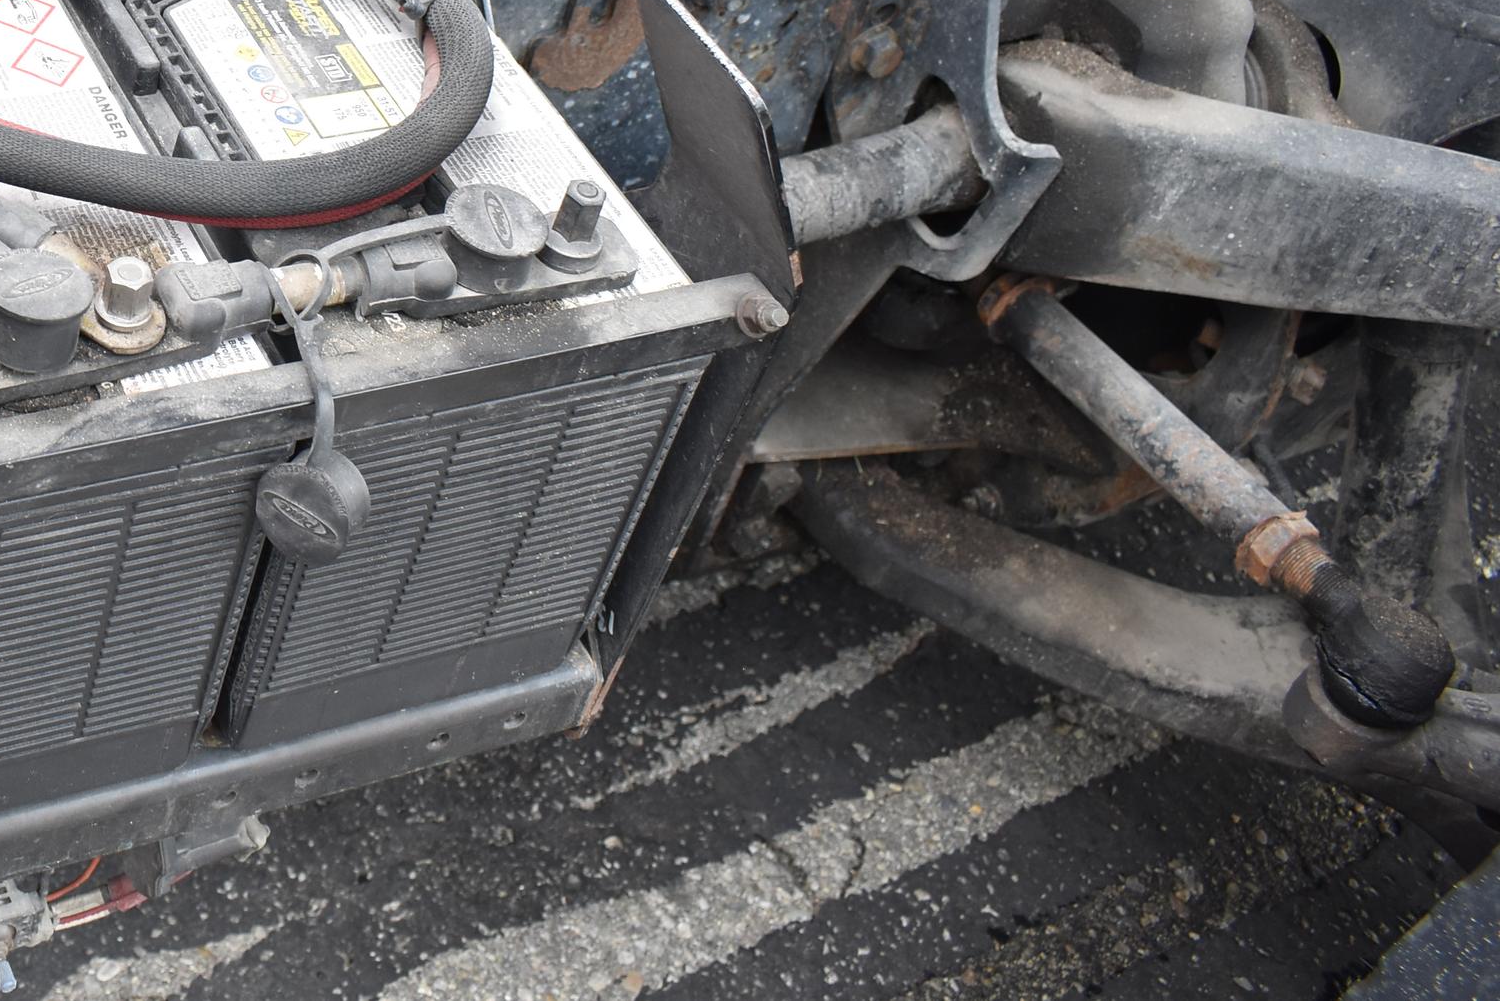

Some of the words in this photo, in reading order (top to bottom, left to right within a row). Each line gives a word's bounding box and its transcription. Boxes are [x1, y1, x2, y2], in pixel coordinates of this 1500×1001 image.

[320, 56, 346, 79] STD
[491, 44, 518, 77] NGER
[88, 84, 128, 141] DANGER
[180, 247, 192, 262] Lead
[243, 345, 256, 361] Acid
